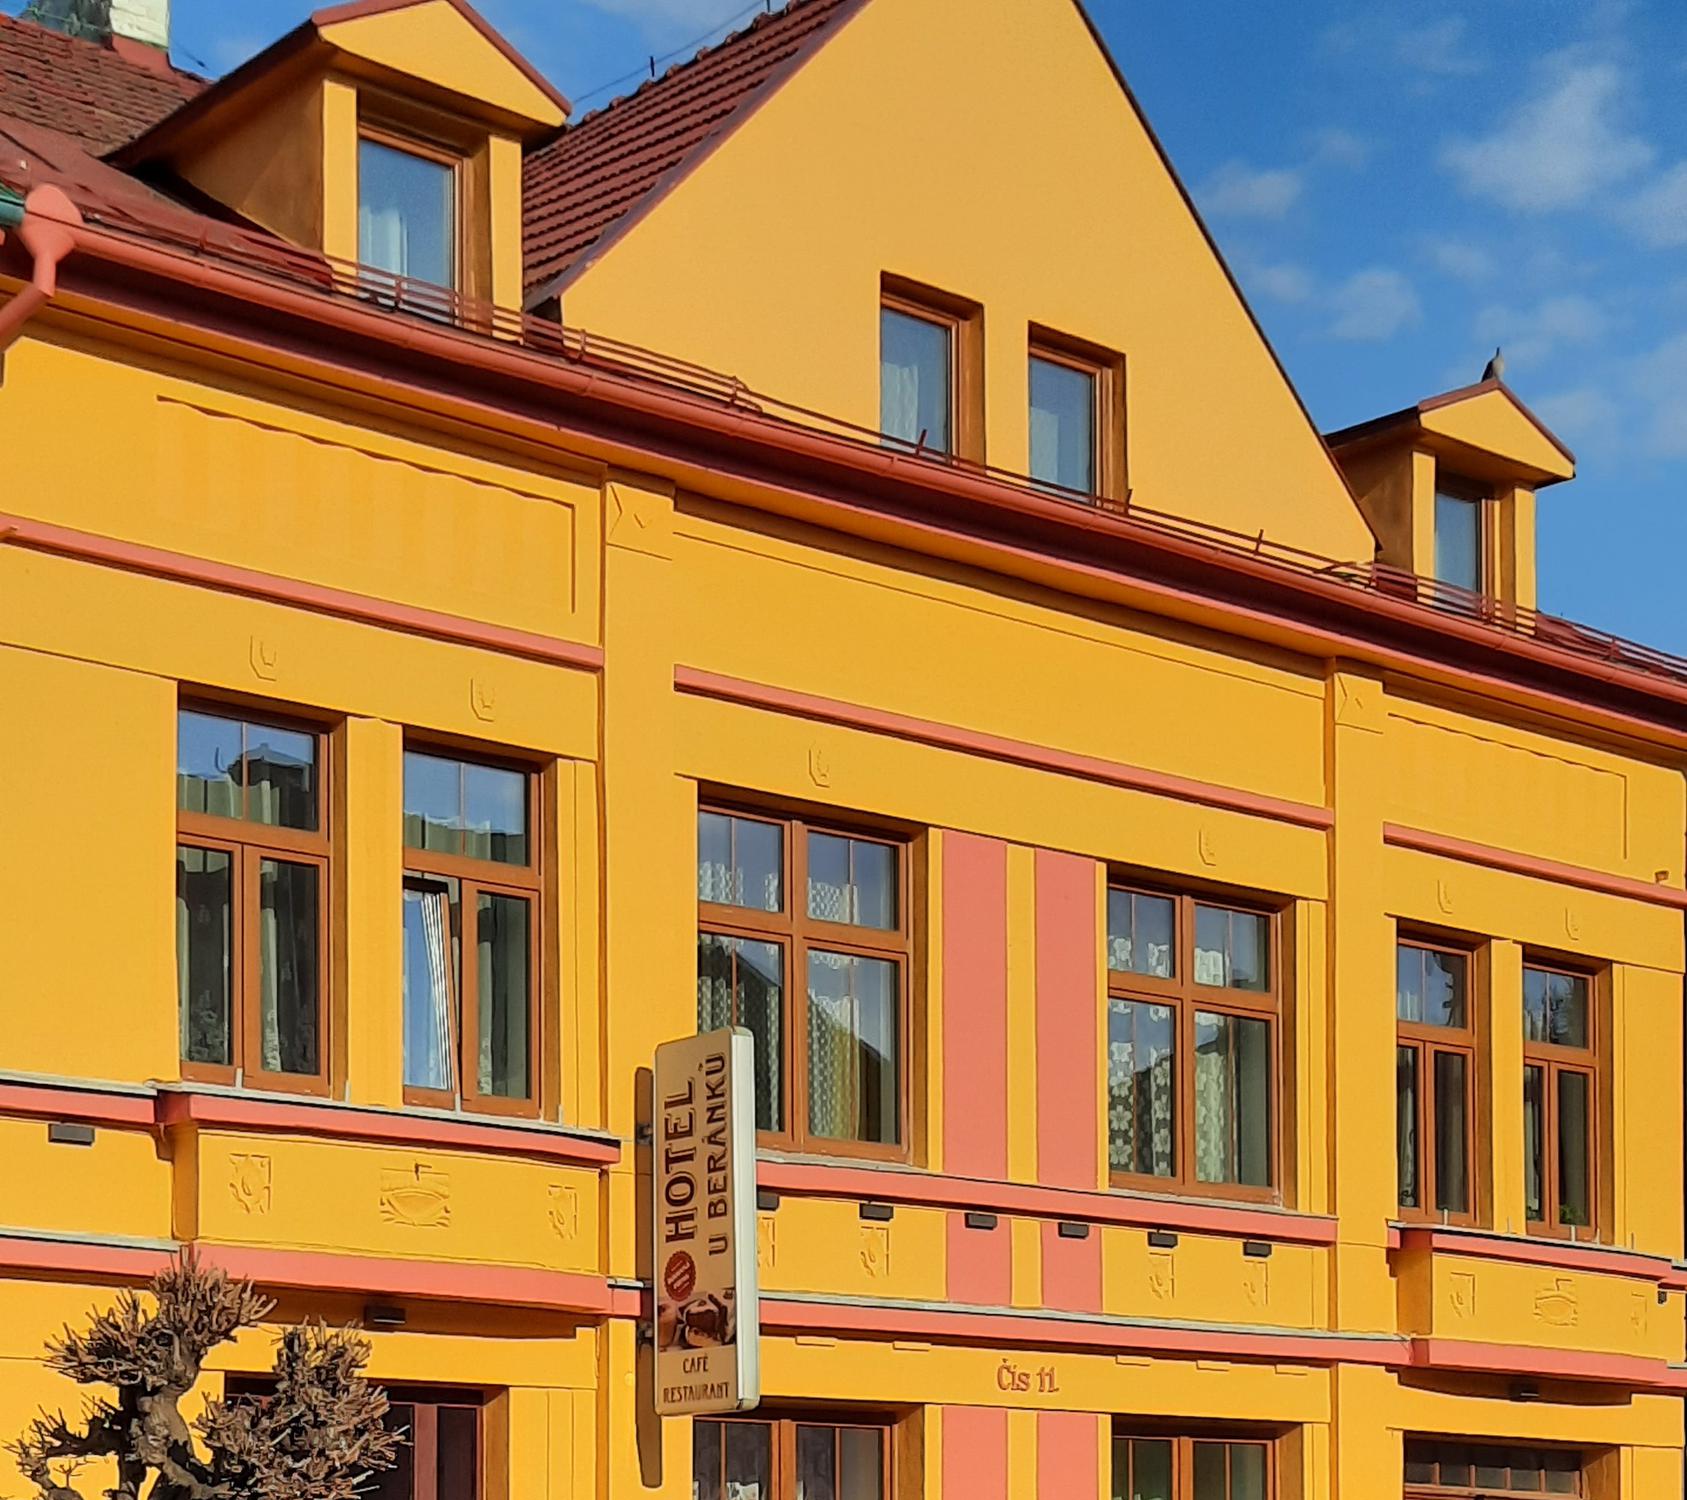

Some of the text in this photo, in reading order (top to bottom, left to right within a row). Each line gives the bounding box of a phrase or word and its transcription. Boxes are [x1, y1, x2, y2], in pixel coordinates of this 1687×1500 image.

[664, 1076, 698, 1243] HOTEL
[699, 1052, 728, 1256] U BERÁNKŮ
[663, 1382, 729, 1403] RESTAURANT
[683, 1354, 708, 1374] CAFÉ
